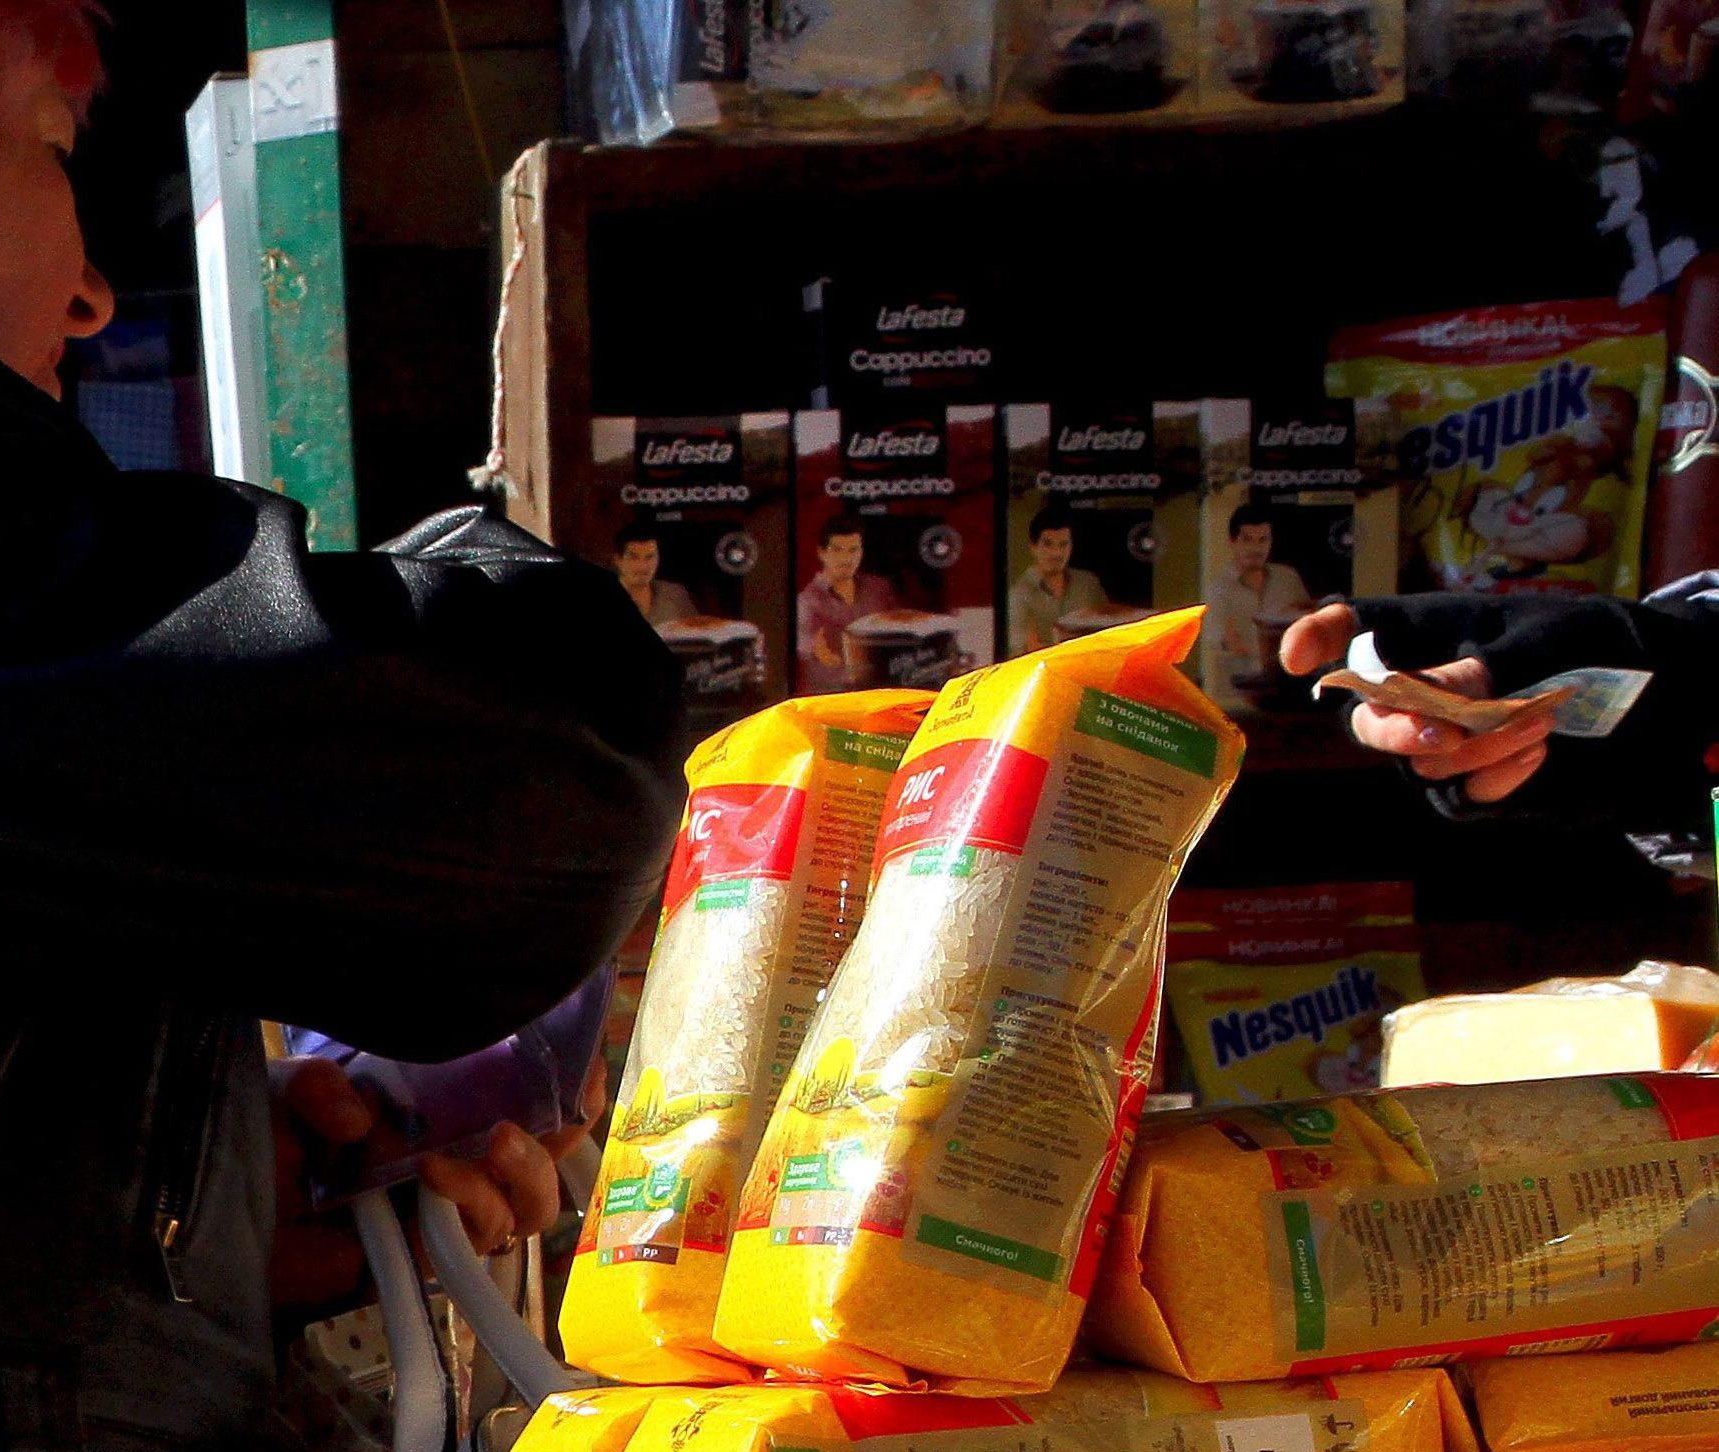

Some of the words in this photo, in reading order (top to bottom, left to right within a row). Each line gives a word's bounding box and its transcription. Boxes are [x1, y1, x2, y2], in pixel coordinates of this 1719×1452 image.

[699, 0, 725, 71] LaFes
[876, 304, 965, 331] LaFesta
[849, 348, 991, 373] Cappuccino
[1400, 358, 1594, 477] esquik
[847, 432, 940, 459] LaFesta
[1058, 424, 1147, 452] LaFesta
[1258, 420, 1348, 447] LaFesta
[642, 439, 734, 466] LaFesta
[824, 476, 955, 498] Cappuccino
[1036, 471, 1161, 493] Cappuccino
[1234, 466, 1361, 487] Cappuccino
[620, 483, 751, 506] Cappuccino
[1116, 716, 1180, 754] сніданок
[865, 745, 903, 762] сніда
[896, 765, 946, 810] РИС
[1208, 965, 1378, 1070] Nesquik
[953, 1232, 1020, 1263] Смачного!
[1295, 1238, 1314, 1304] Смачного!
